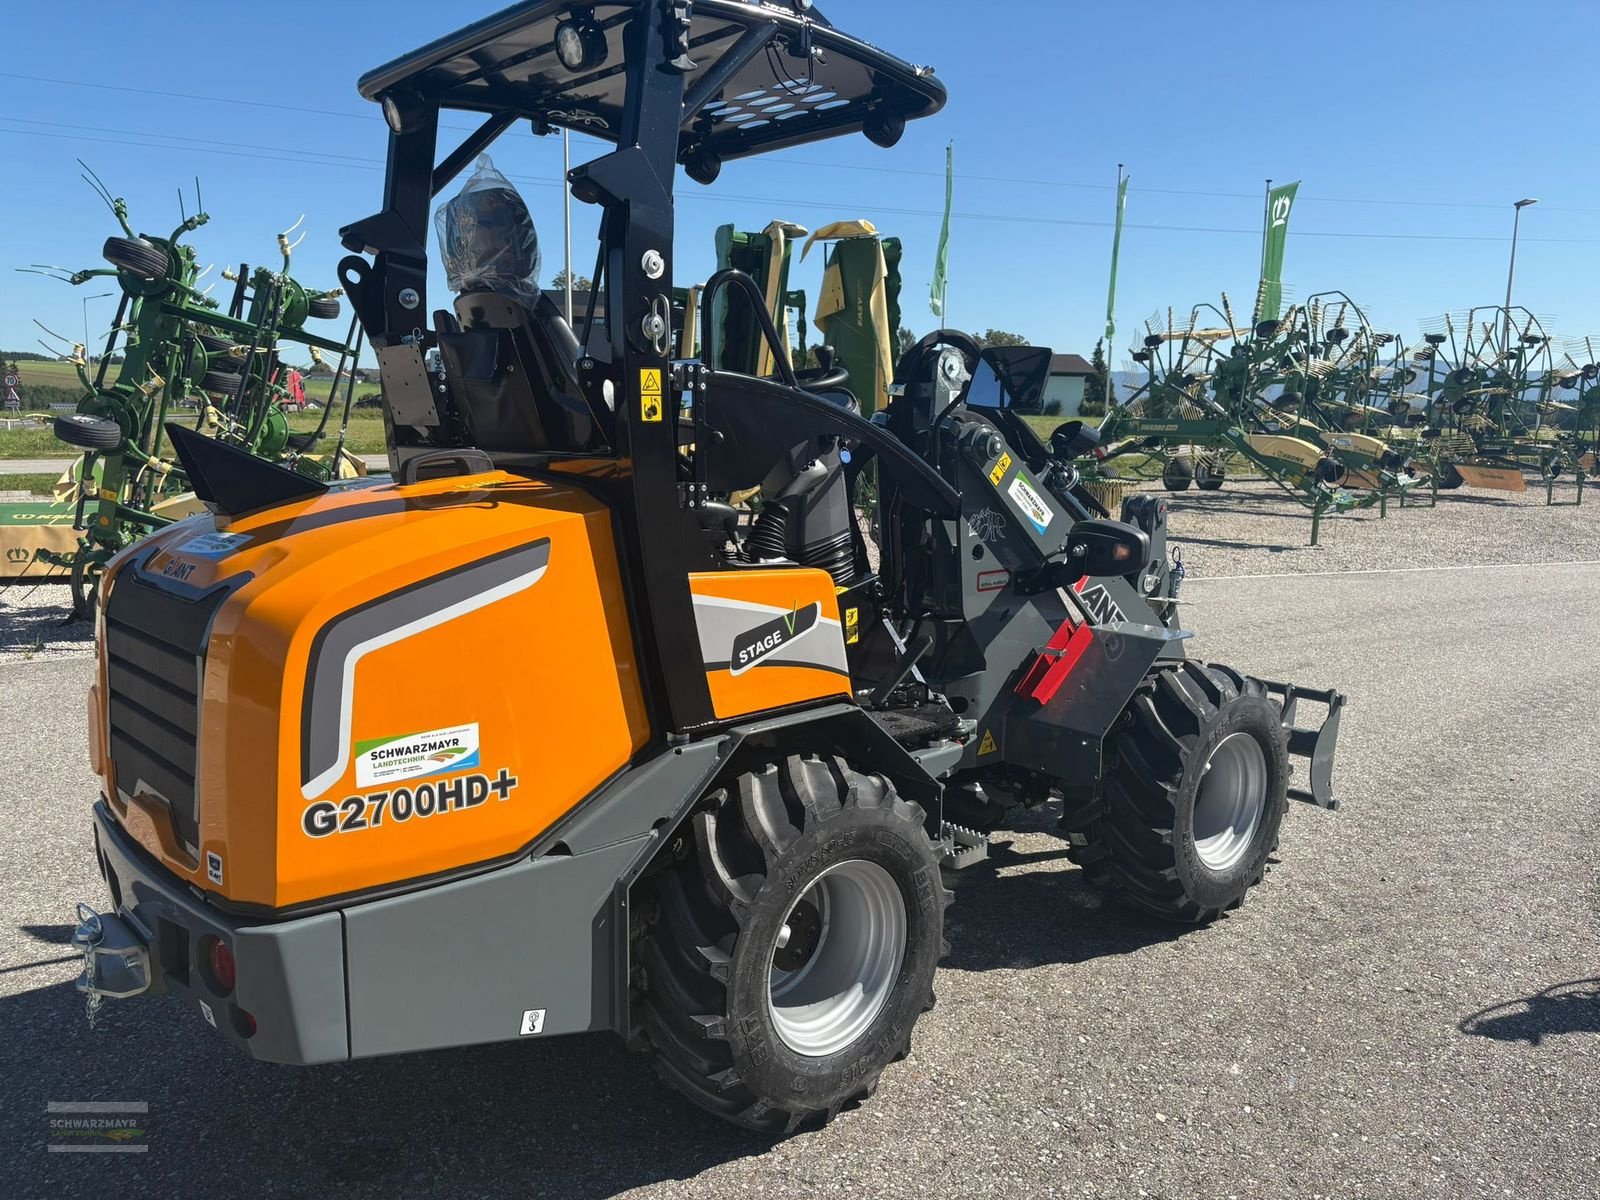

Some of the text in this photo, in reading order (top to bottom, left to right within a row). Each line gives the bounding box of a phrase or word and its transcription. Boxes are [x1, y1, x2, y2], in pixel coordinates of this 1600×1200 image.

[1282, 452, 1305, 463] KRONE
[1018, 482, 1045, 516] SCHWARZMAYR
[163, 556, 197, 581] GIANT
[739, 600, 798, 663] STAGE V
[370, 738, 460, 761] SCHWARZMAYR
[372, 755, 426, 769] LANDTECHNIK
[301, 767, 518, 838] G2700HD+
